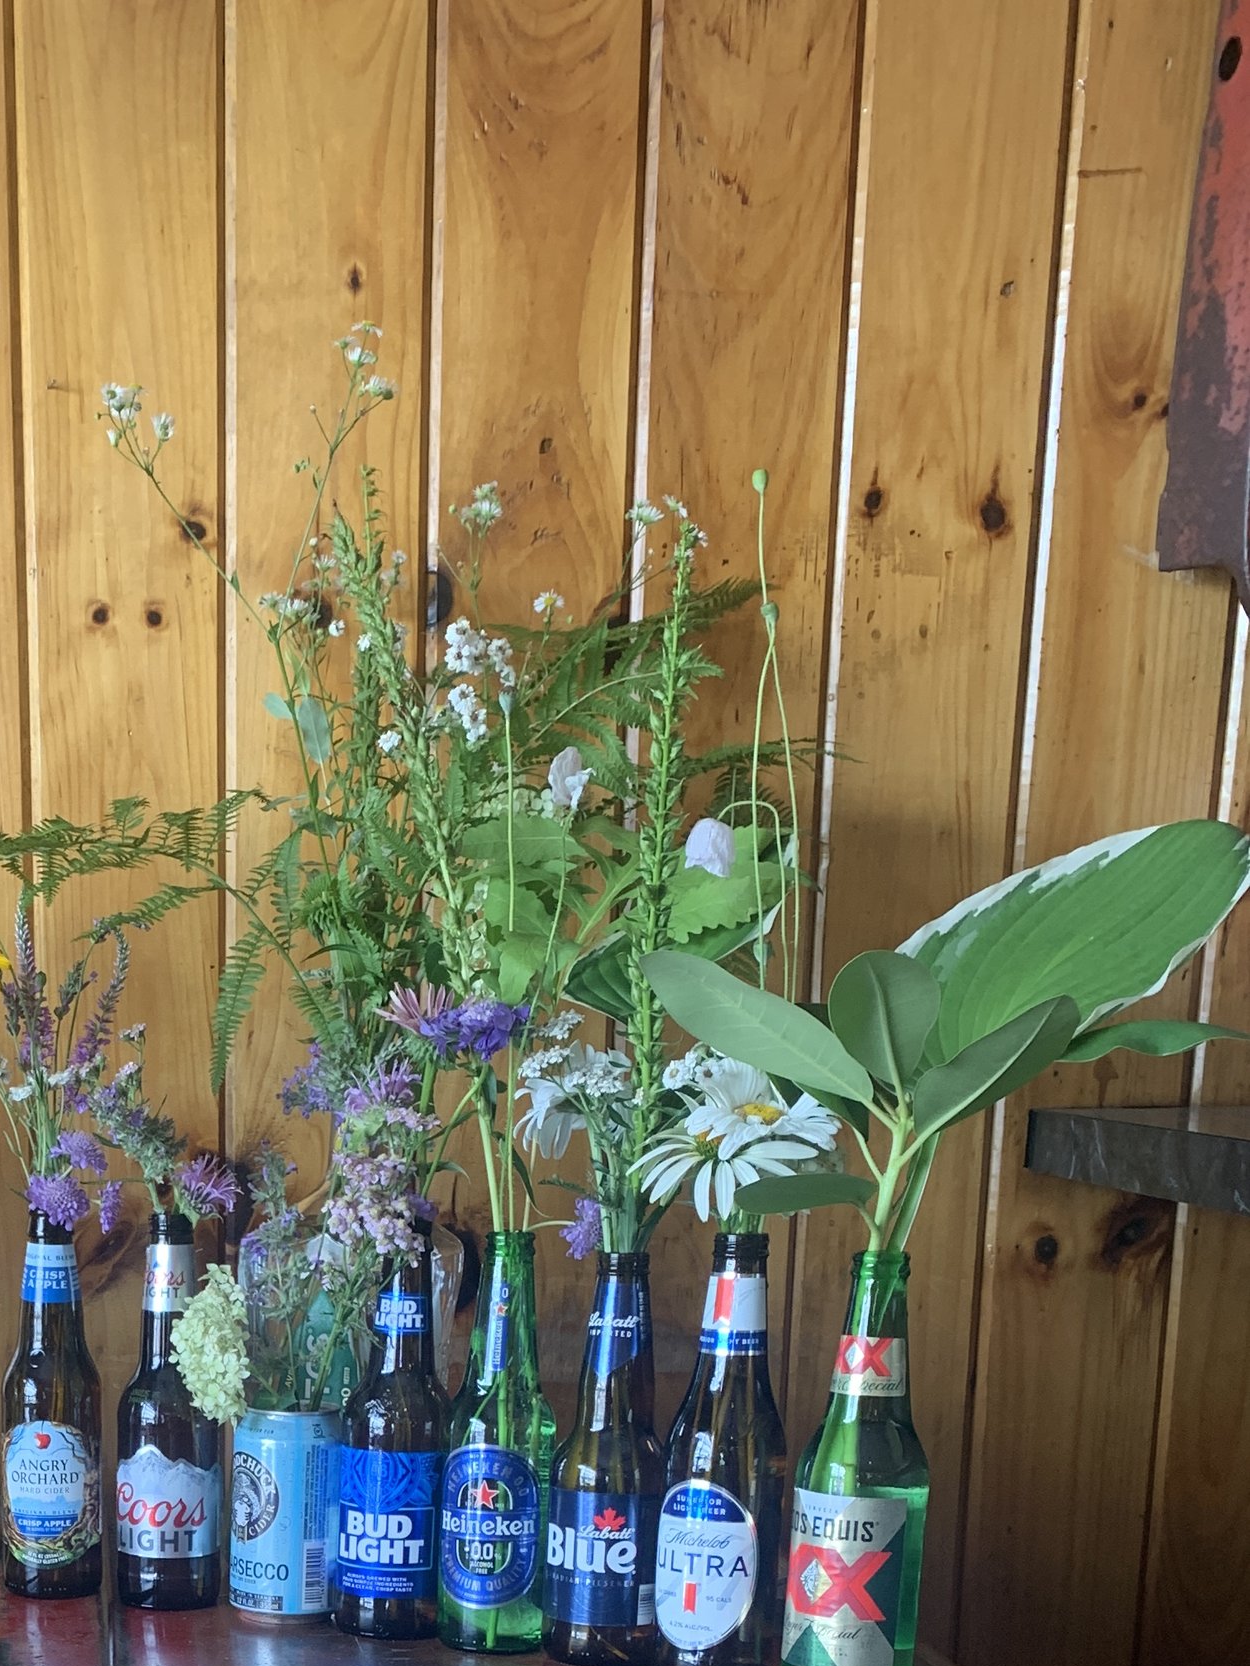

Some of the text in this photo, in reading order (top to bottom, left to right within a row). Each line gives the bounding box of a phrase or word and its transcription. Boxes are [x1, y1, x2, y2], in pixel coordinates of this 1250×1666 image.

[27, 1279, 68, 1290] APPLE
[29, 1269, 66, 1280] CRISP
[145, 1286, 181, 1298] IGHT
[380, 1298, 418, 1315] BUD
[374, 1311, 424, 1329] LIGHT
[11, 1470, 79, 1485] ORCHARD
[19, 1458, 70, 1472] ANGRY
[447, 1461, 513, 1493] HEINEKEN
[19, 1486, 70, 1495] HARD CIDER
[116, 1481, 208, 1529] Coors
[18, 1518, 72, 1528] CRISP APPLE
[248, 1503, 276, 1537] CIDER
[346, 1509, 413, 1540] BUD
[441, 1508, 536, 1536] Heineken
[576, 1523, 635, 1540] Labatt
[812, 1516, 875, 1543] EQUIS
[119, 1525, 198, 1553] LIGHT
[339, 1532, 425, 1565] LIGHT
[546, 1522, 637, 1575] Blue
[664, 1527, 735, 1550] Michelob
[656, 1546, 749, 1578] ULTRA
[485, 1558, 527, 1592] QUALITY
